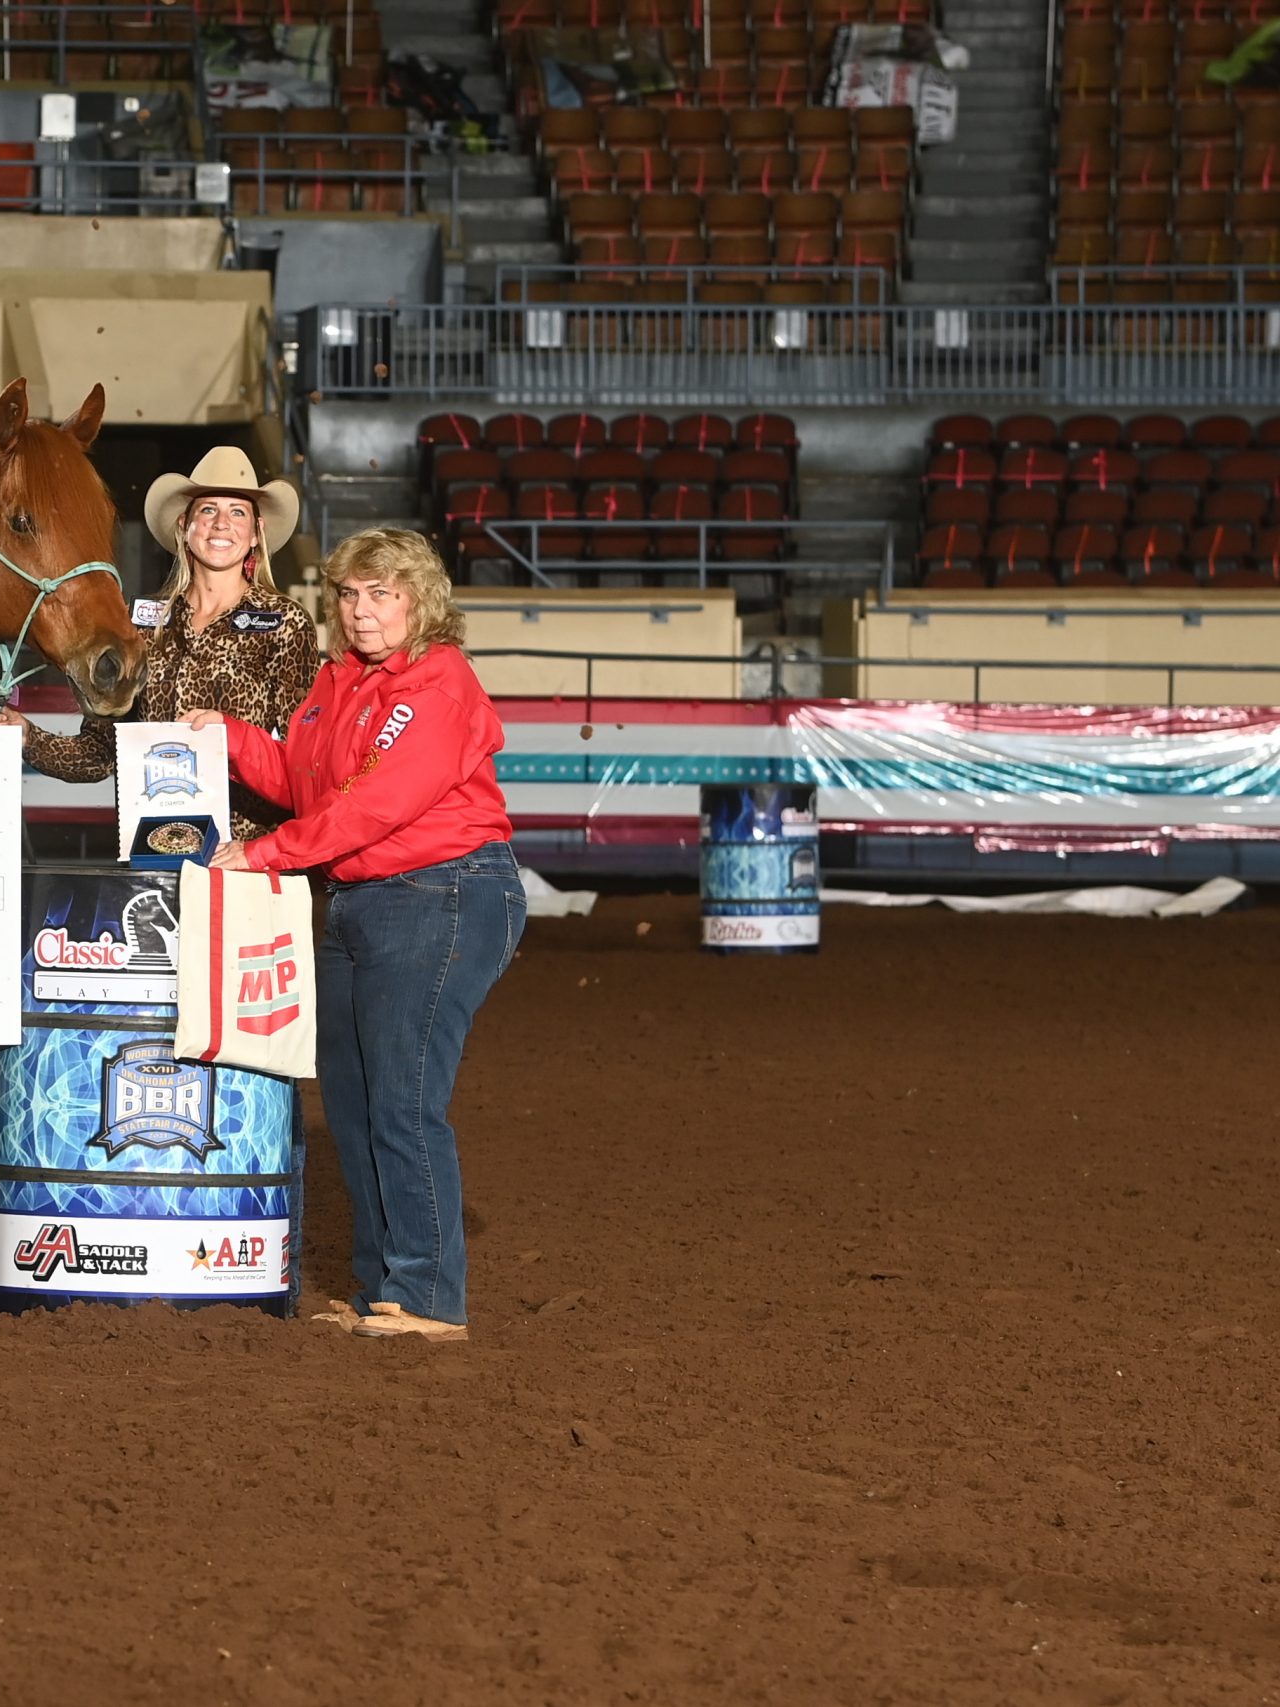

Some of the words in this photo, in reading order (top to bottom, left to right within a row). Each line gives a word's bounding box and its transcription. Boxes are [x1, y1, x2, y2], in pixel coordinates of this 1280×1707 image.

[374, 703, 415, 751] OKC
[37, 931, 125, 966] Classic
[238, 960, 296, 1003] MP
[37, 986, 109, 998] PLAY
[126, 1048, 159, 1060] WORLD
[121, 1068, 174, 1086] OKLAHOMA
[177, 1071, 198, 1083] CITY
[141, 1065, 175, 1074] XVIII
[115, 1074, 202, 1125] BBR
[118, 1120, 146, 1135] STATE
[149, 1119, 170, 1129] FAIR
[173, 1121, 197, 1136] PARK
[78, 1245, 145, 1258] SADDLE
[83, 1258, 96, 1270] &
[100, 1259, 145, 1271] TACK
